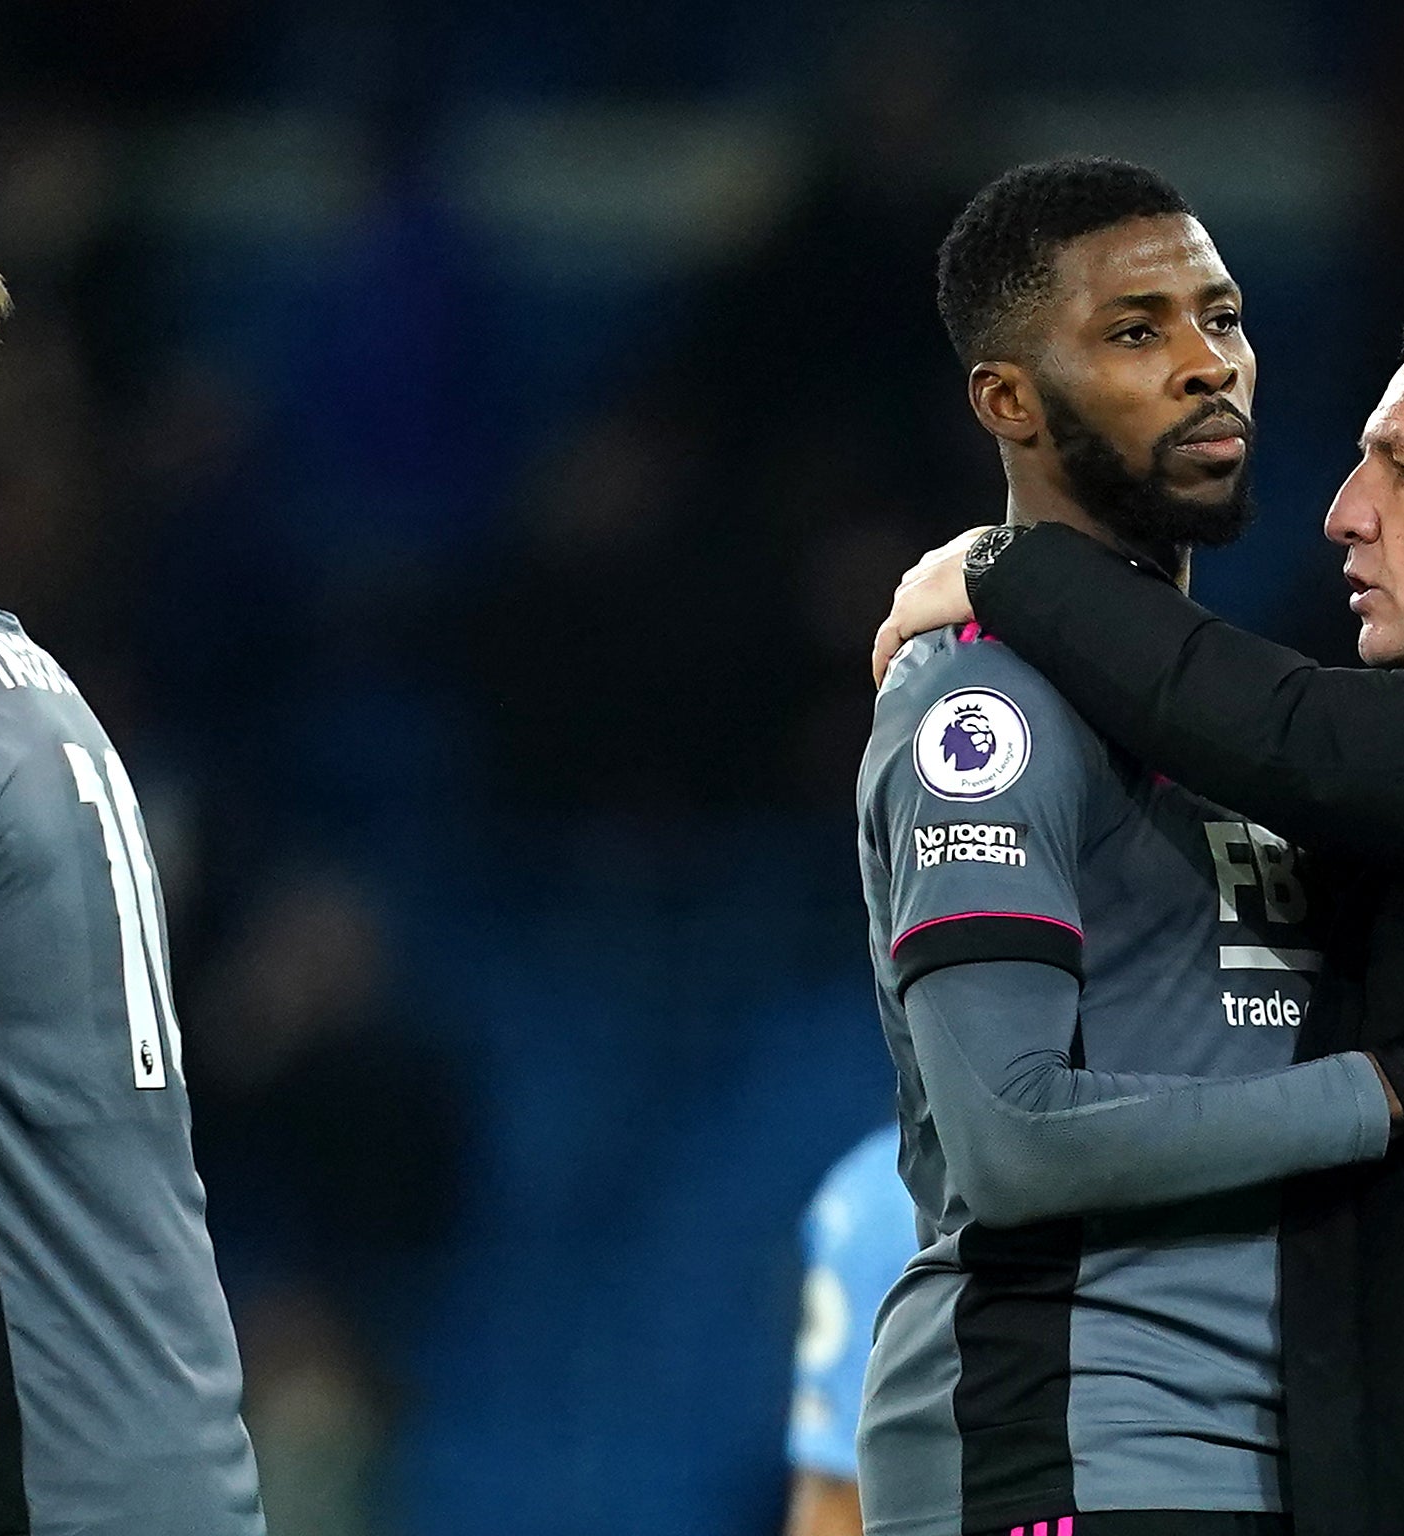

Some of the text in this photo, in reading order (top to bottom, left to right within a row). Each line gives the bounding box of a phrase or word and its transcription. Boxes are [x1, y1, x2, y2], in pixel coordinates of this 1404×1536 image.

[961, 741, 1014, 788] Premier League
[914, 822, 1017, 848] No room
[946, 842, 1027, 869] racism
[1203, 821, 1308, 925] FB
[1221, 990, 1301, 1027] trade
